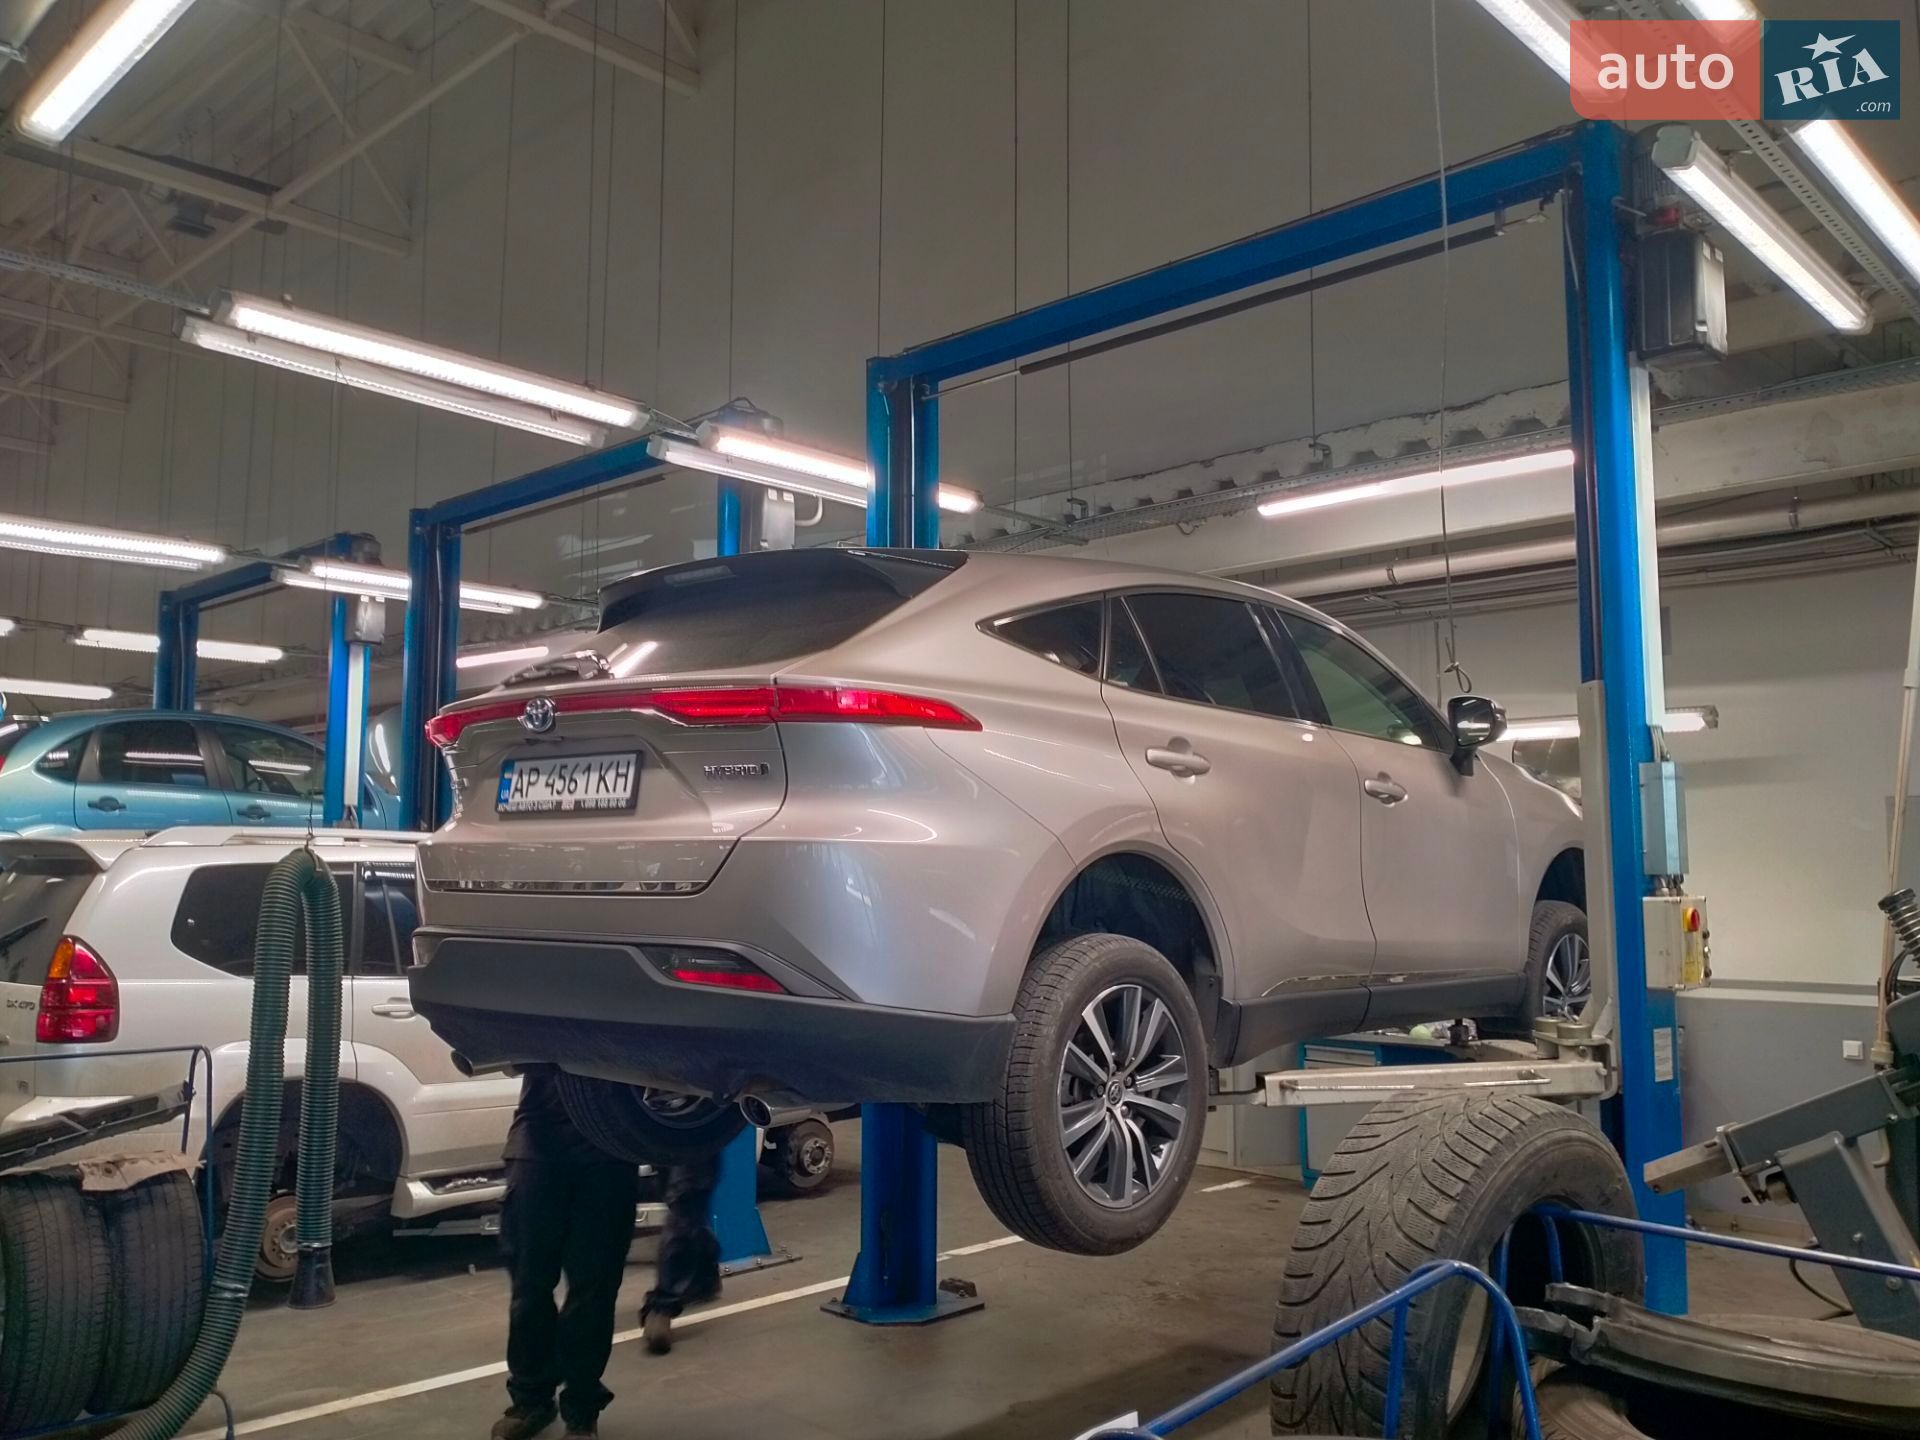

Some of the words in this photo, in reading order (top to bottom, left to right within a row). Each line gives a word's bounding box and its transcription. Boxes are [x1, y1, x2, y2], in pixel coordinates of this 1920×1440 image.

[511, 767, 541, 799] AP
[545, 762, 593, 796] 4561
[596, 760, 631, 793] KH
[703, 764, 759, 776] HYBRID
